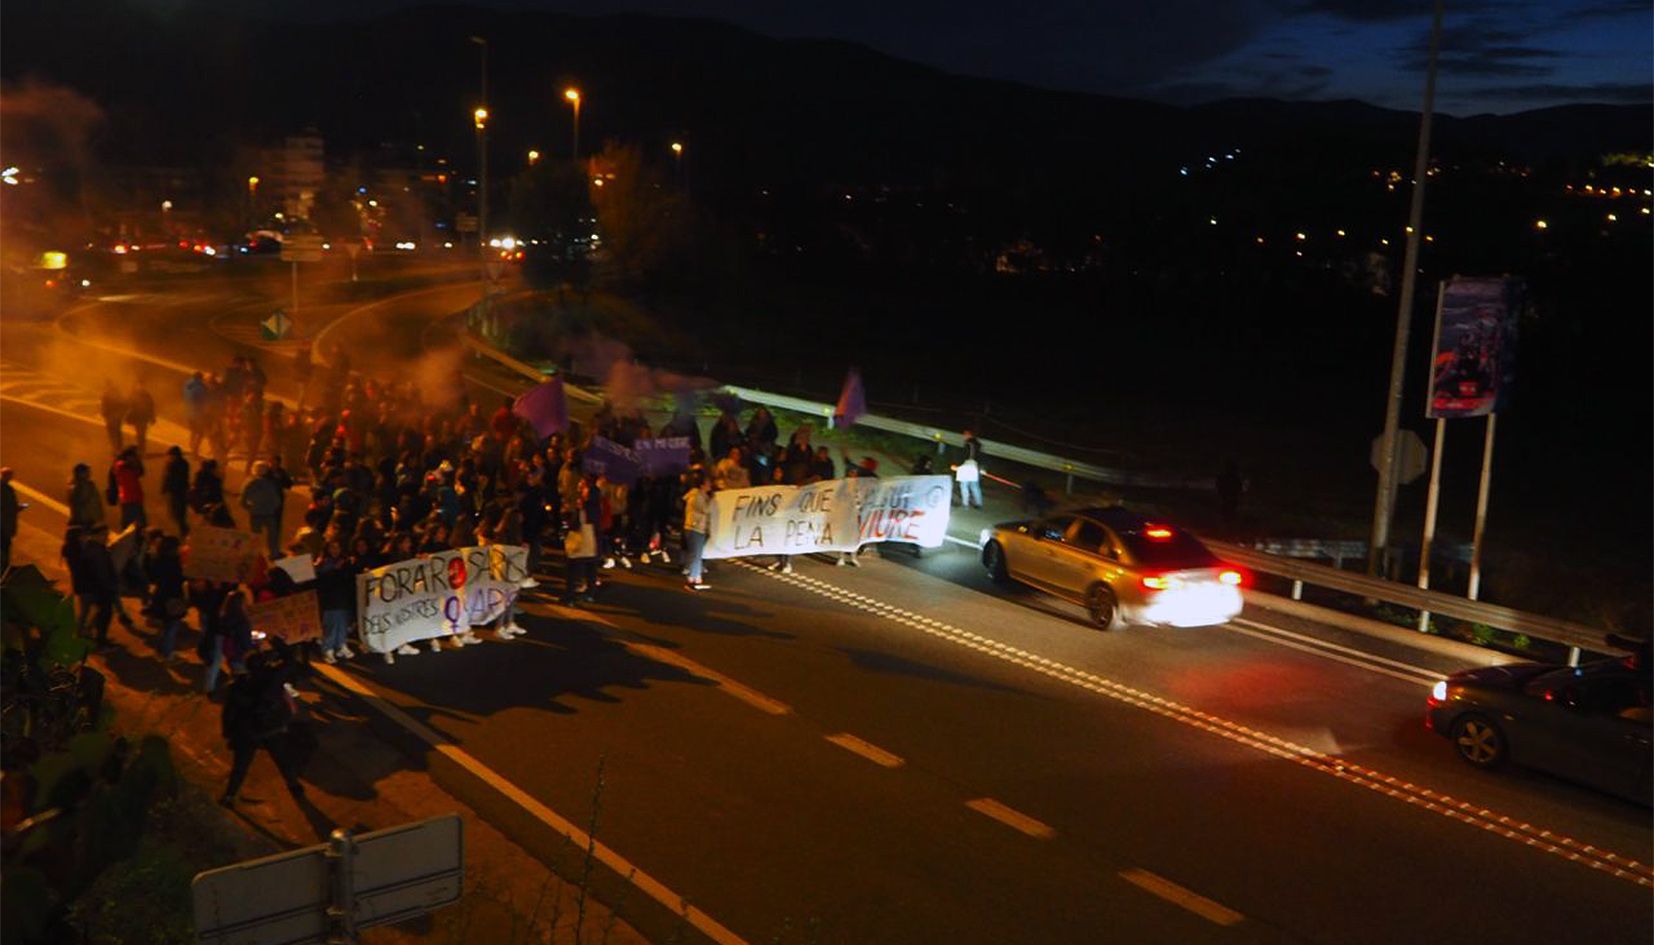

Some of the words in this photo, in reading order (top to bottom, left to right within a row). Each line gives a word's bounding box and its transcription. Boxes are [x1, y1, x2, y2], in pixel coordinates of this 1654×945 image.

[732, 493, 783, 523] FINS
[798, 488, 834, 514] QUE
[733, 525, 764, 550] LA
[784, 519, 833, 547] PENA
[363, 611, 391, 635] DELS
